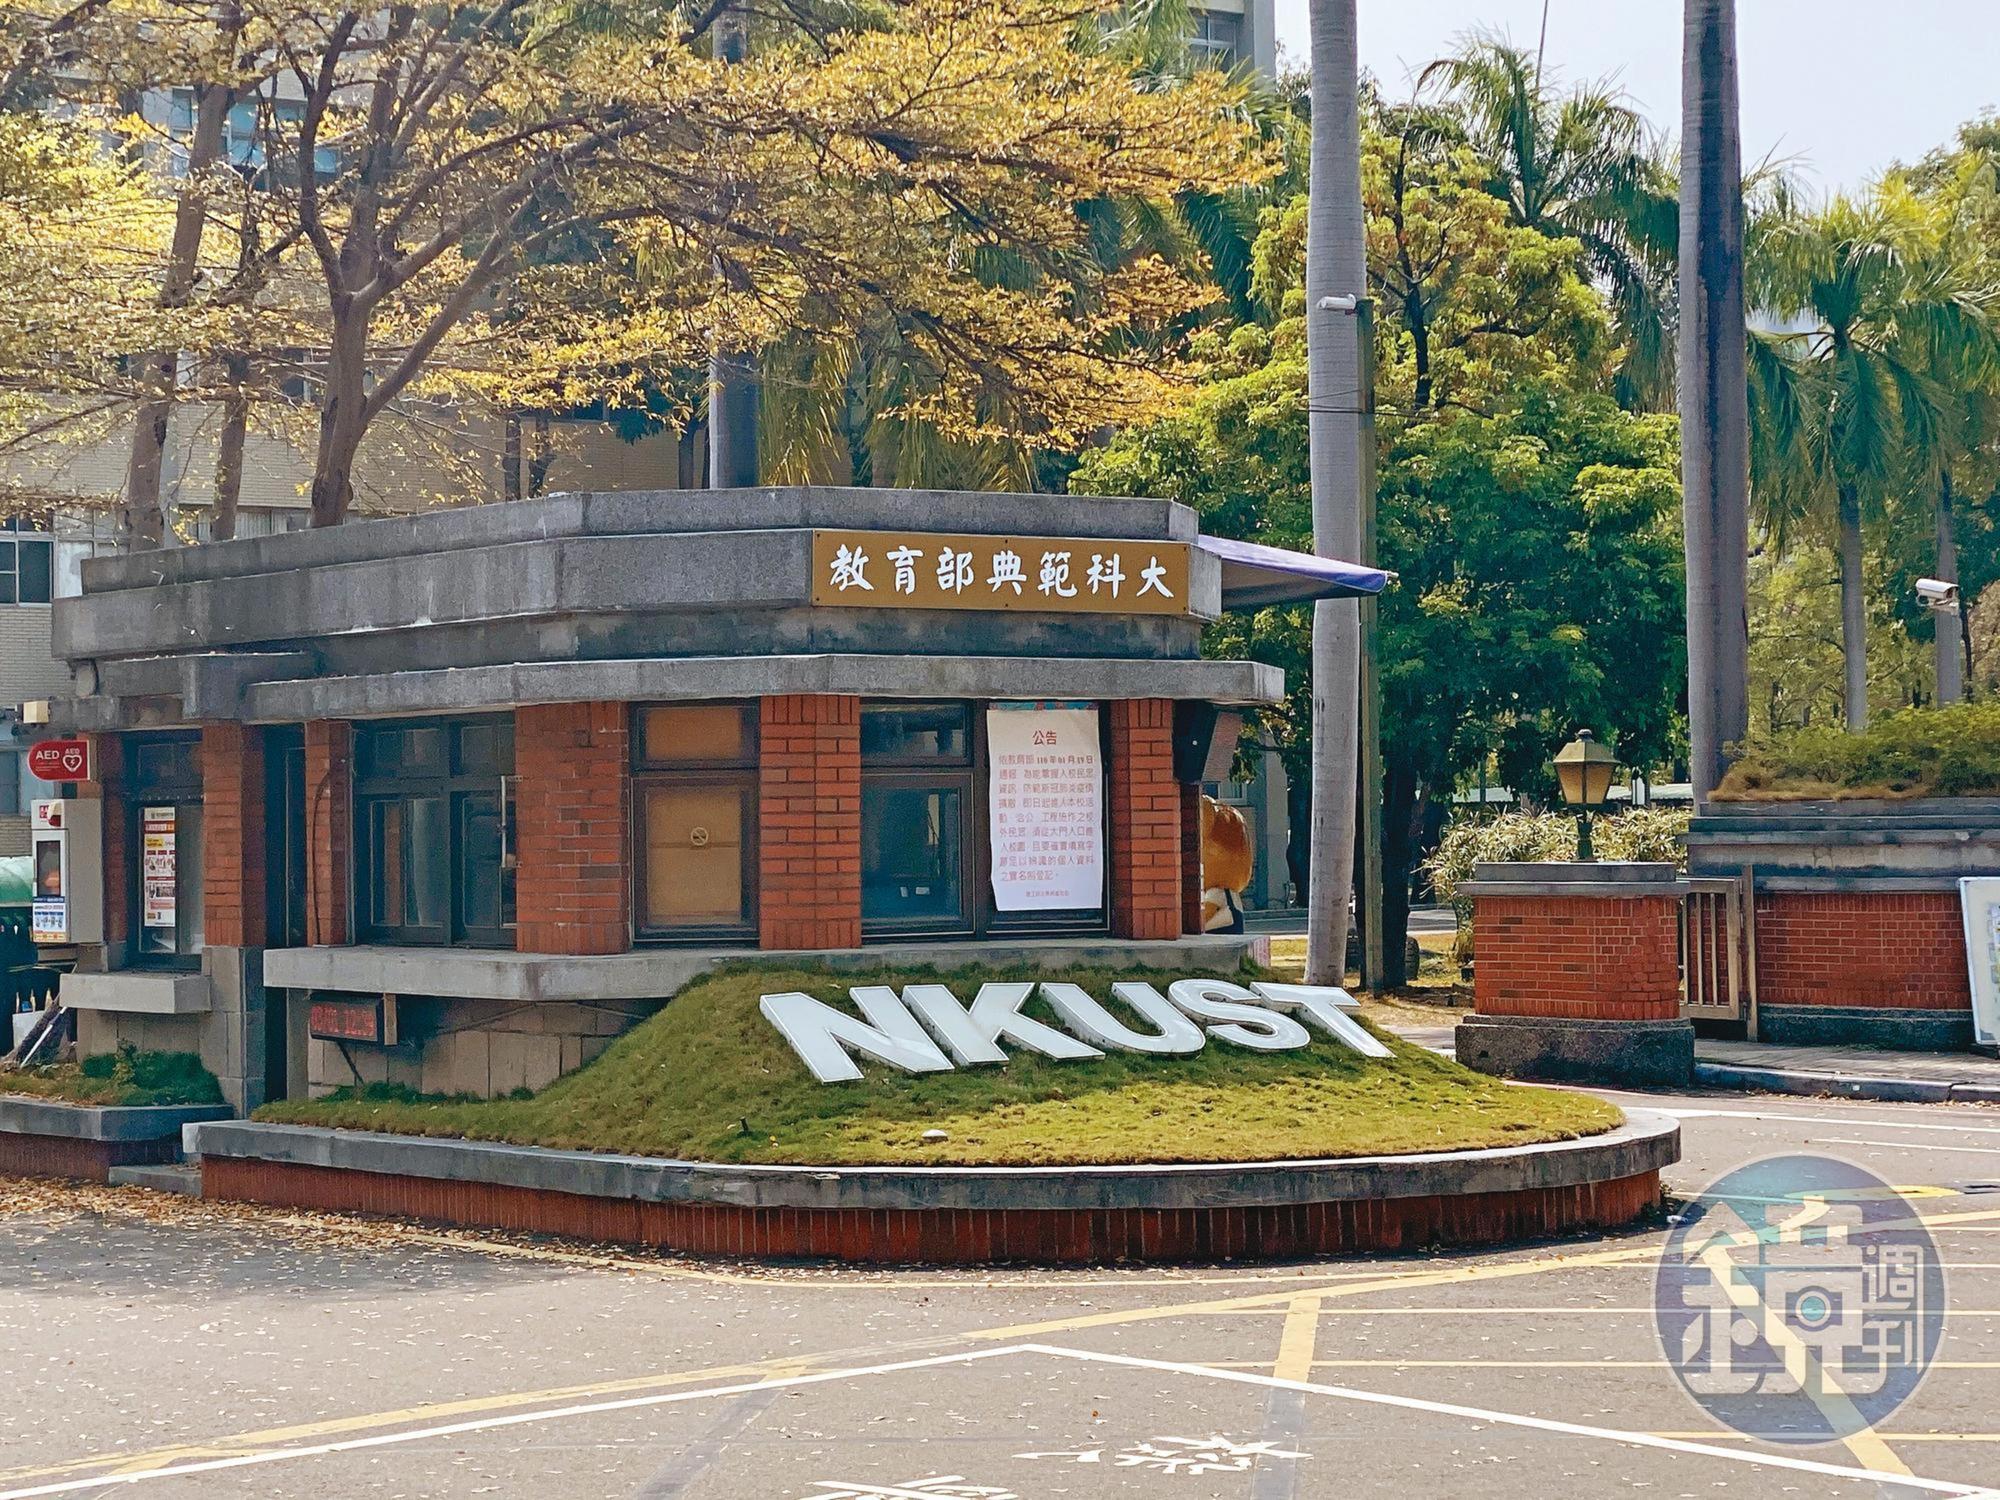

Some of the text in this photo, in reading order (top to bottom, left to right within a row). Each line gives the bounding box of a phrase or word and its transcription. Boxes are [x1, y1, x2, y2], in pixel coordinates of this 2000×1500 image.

[829, 543, 1175, 599] 教育部典範科大
[35, 750, 60, 760] AED
[1032, 730, 1057, 746] 公告
[759, 978, 1398, 1084] NKUST
